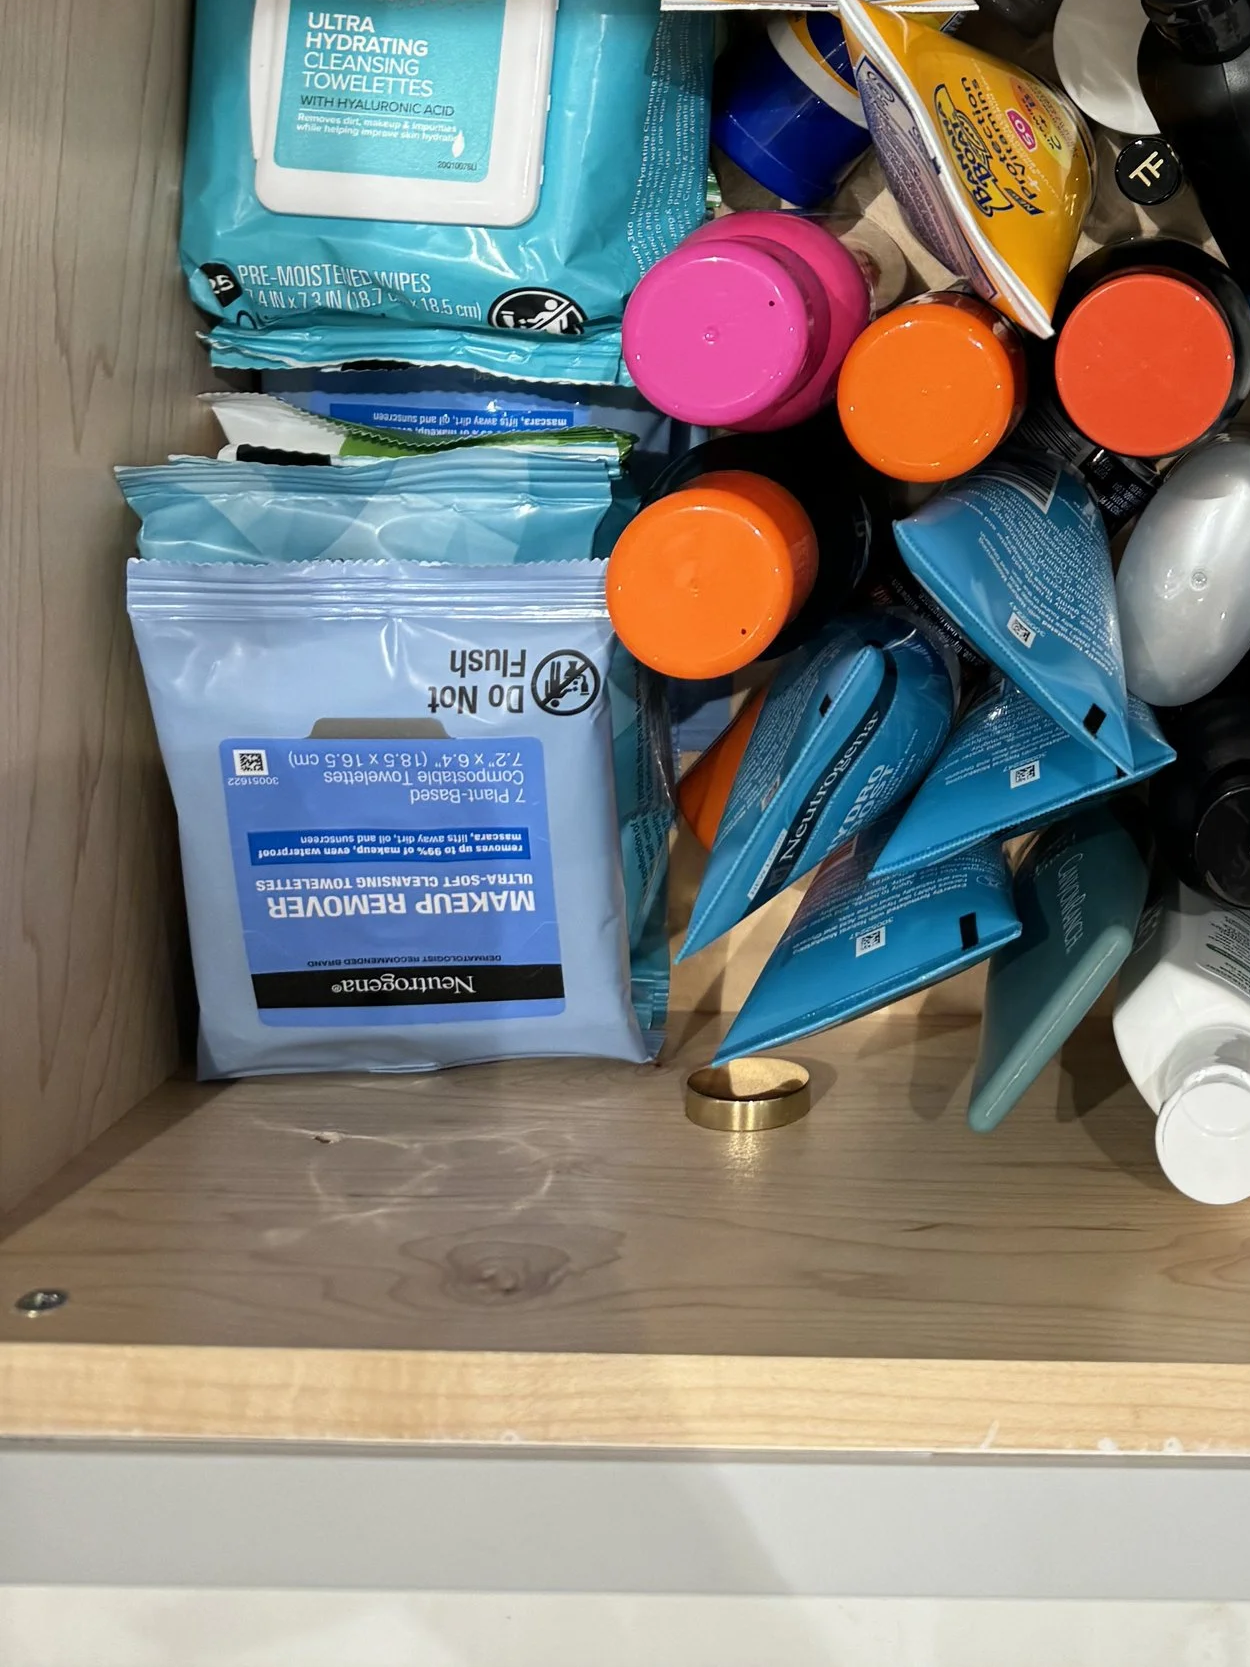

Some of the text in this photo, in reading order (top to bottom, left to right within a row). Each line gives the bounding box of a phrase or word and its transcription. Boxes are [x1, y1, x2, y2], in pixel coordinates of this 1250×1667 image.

[307, 11, 375, 32] ULTRA
[305, 31, 429, 57] HYDRATING
[303, 51, 419, 75] CLEANSING
[301, 71, 433, 97] TOWELETTES
[300, 94, 454, 116] WITH HYALURONIC ACID
[959, 75, 1037, 200] Protection
[970, 77, 1026, 175] Vitamins
[1129, 151, 1165, 186] TF
[237, 262, 431, 293] PRE-MOISTENED WIPES
[449, 649, 526, 677] Flush
[427, 684, 523, 713] Do Not
[323, 768, 523, 785] Compostable Towelettes
[410, 787, 525, 803] 7 Plant-Based
[300, 831, 521, 844] mascara, lifts away dirt, oil and sunscreen
[255, 873, 532, 890] ULTRA-SOFT CLEANSING TOWELETTES
[266, 889, 535, 917] MAKEUP REMOVER
